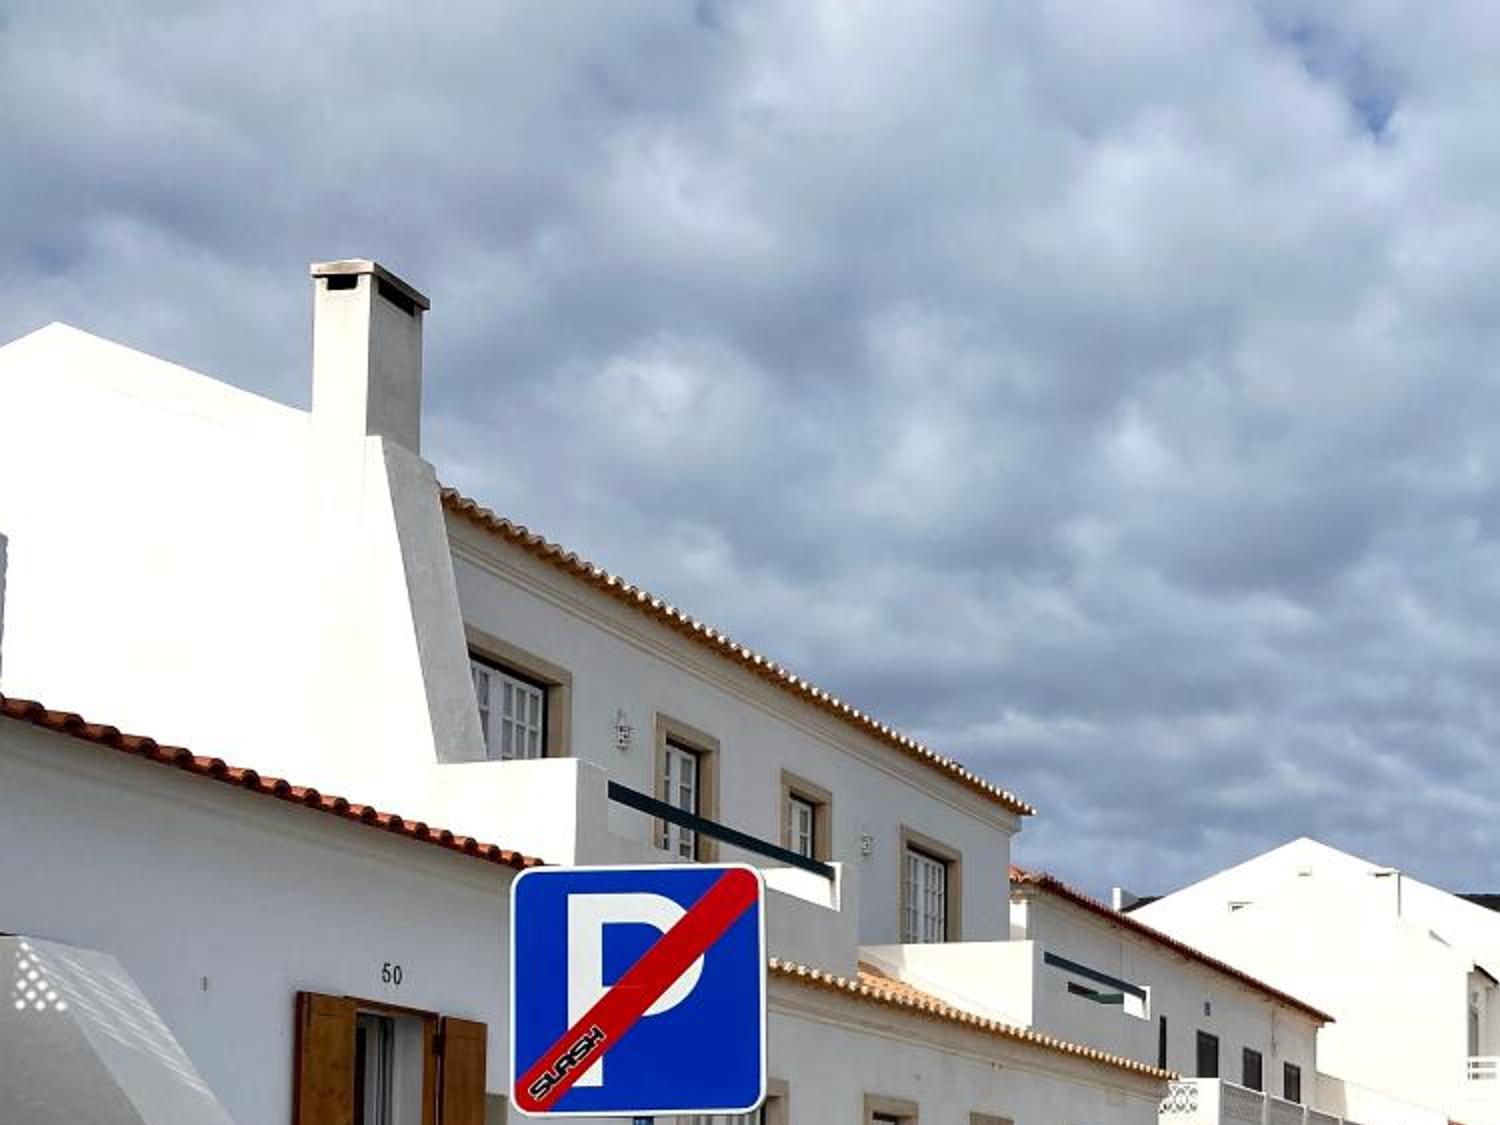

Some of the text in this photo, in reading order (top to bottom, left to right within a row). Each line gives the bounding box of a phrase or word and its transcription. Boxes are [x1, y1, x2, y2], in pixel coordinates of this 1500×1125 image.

[381, 962, 403, 985] 50
[567, 892, 705, 1088] P
[528, 1024, 607, 1101] SLASH
